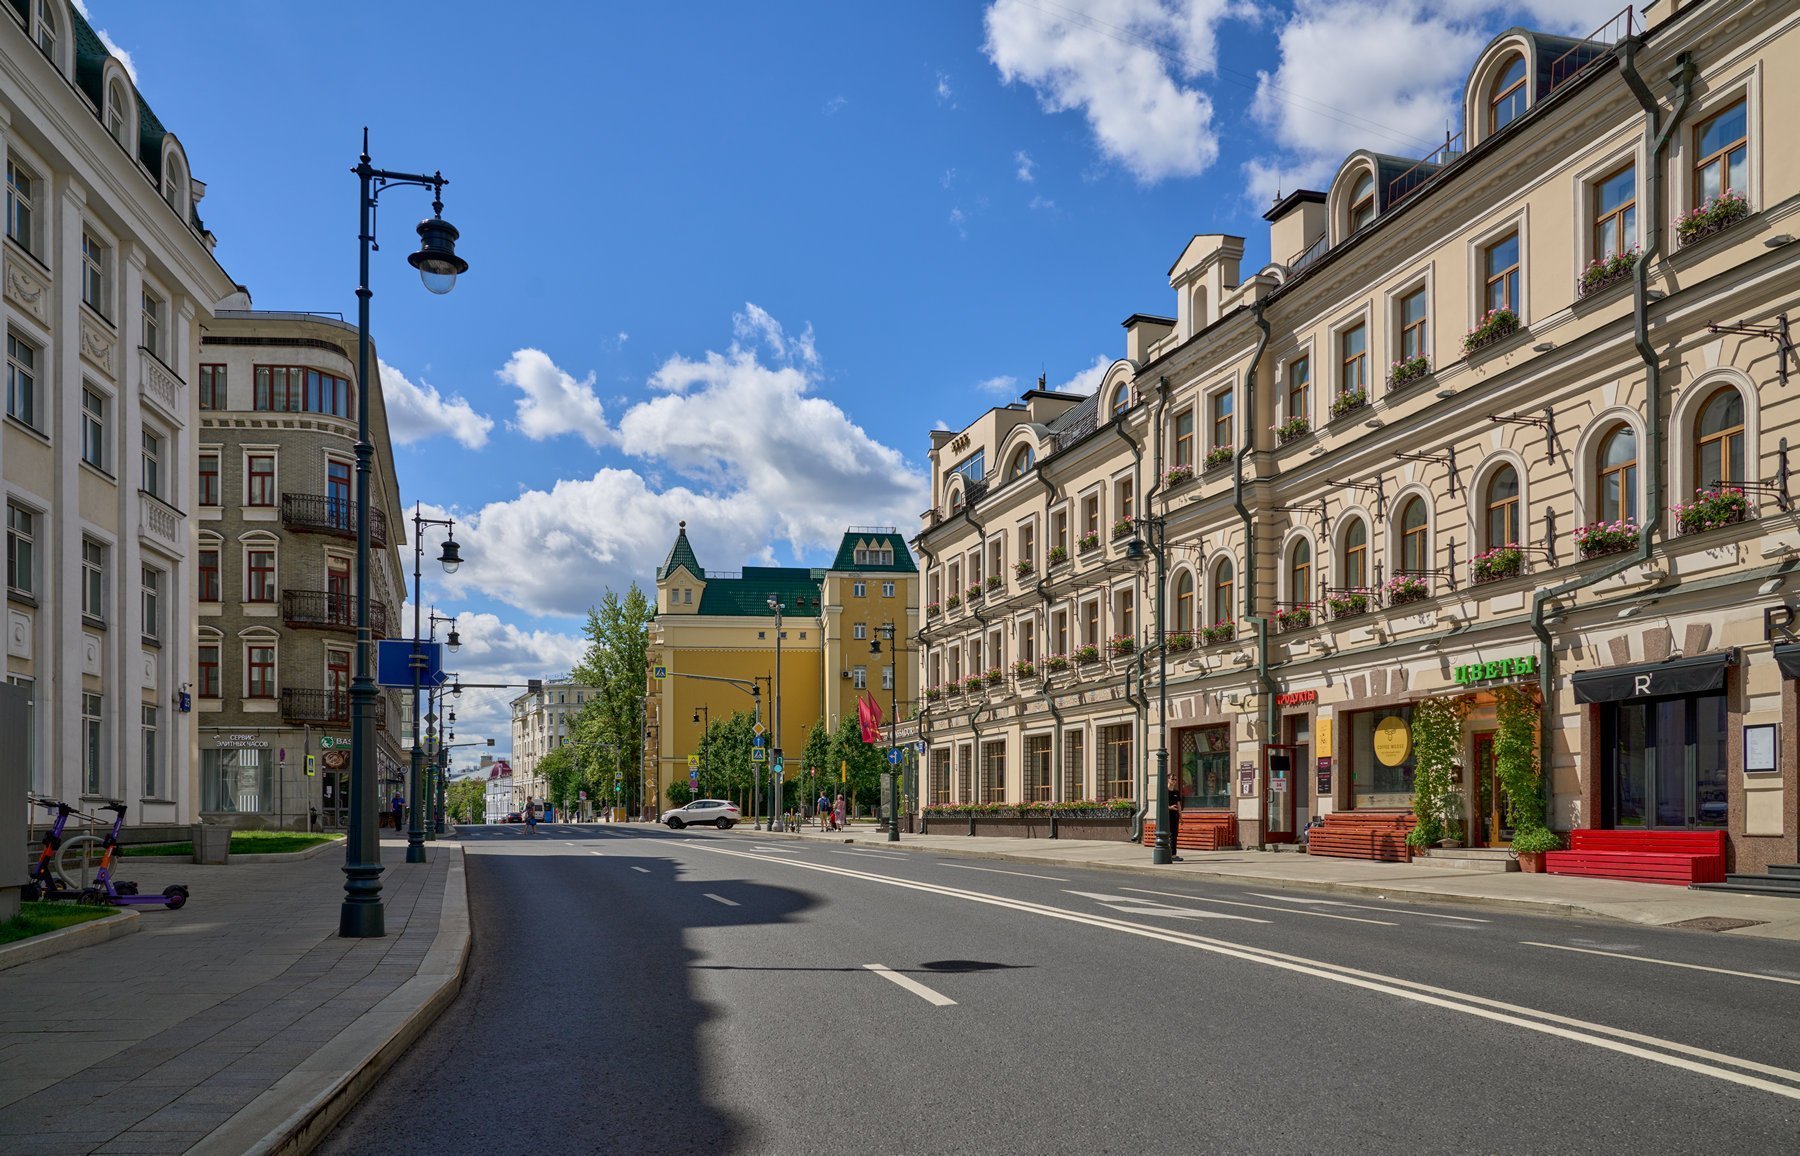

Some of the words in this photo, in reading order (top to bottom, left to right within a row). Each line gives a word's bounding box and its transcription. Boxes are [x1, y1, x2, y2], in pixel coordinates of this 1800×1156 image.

[1764, 605, 1797, 641] R
[1454, 655, 1536, 685] ЦВЕТЫ
[1277, 690, 1316, 705] ПРОДУКТЫ
